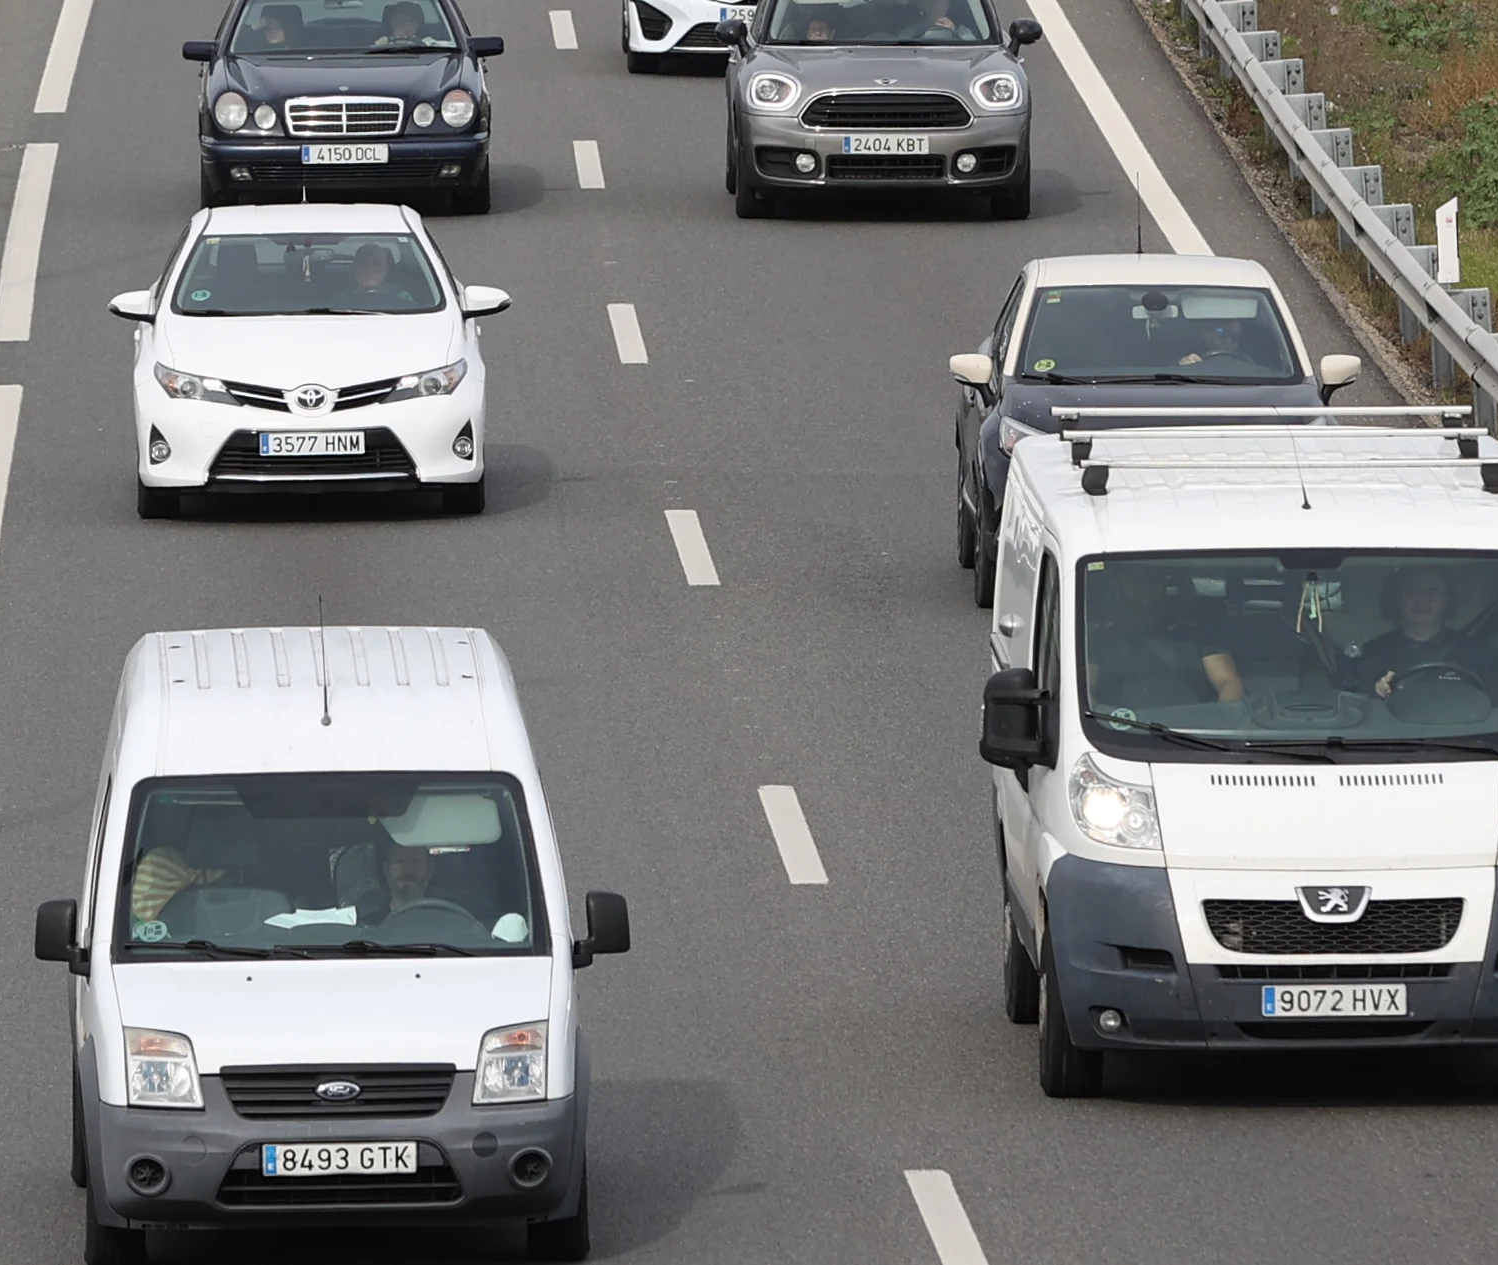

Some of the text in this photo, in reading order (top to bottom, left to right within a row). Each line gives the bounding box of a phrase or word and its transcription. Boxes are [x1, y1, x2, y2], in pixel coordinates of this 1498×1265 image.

[730, 9, 755, 22] 259
[854, 138, 924, 152] 2404 KBT
[316, 147, 382, 161] 4150 DCL
[272, 436, 317, 453] 3577
[325, 434, 360, 452] HNM
[1280, 989, 1343, 1012] 9072
[1352, 989, 1400, 1012] HVX
[282, 1148, 349, 1171] 8493
[360, 1146, 412, 1170] GTK
